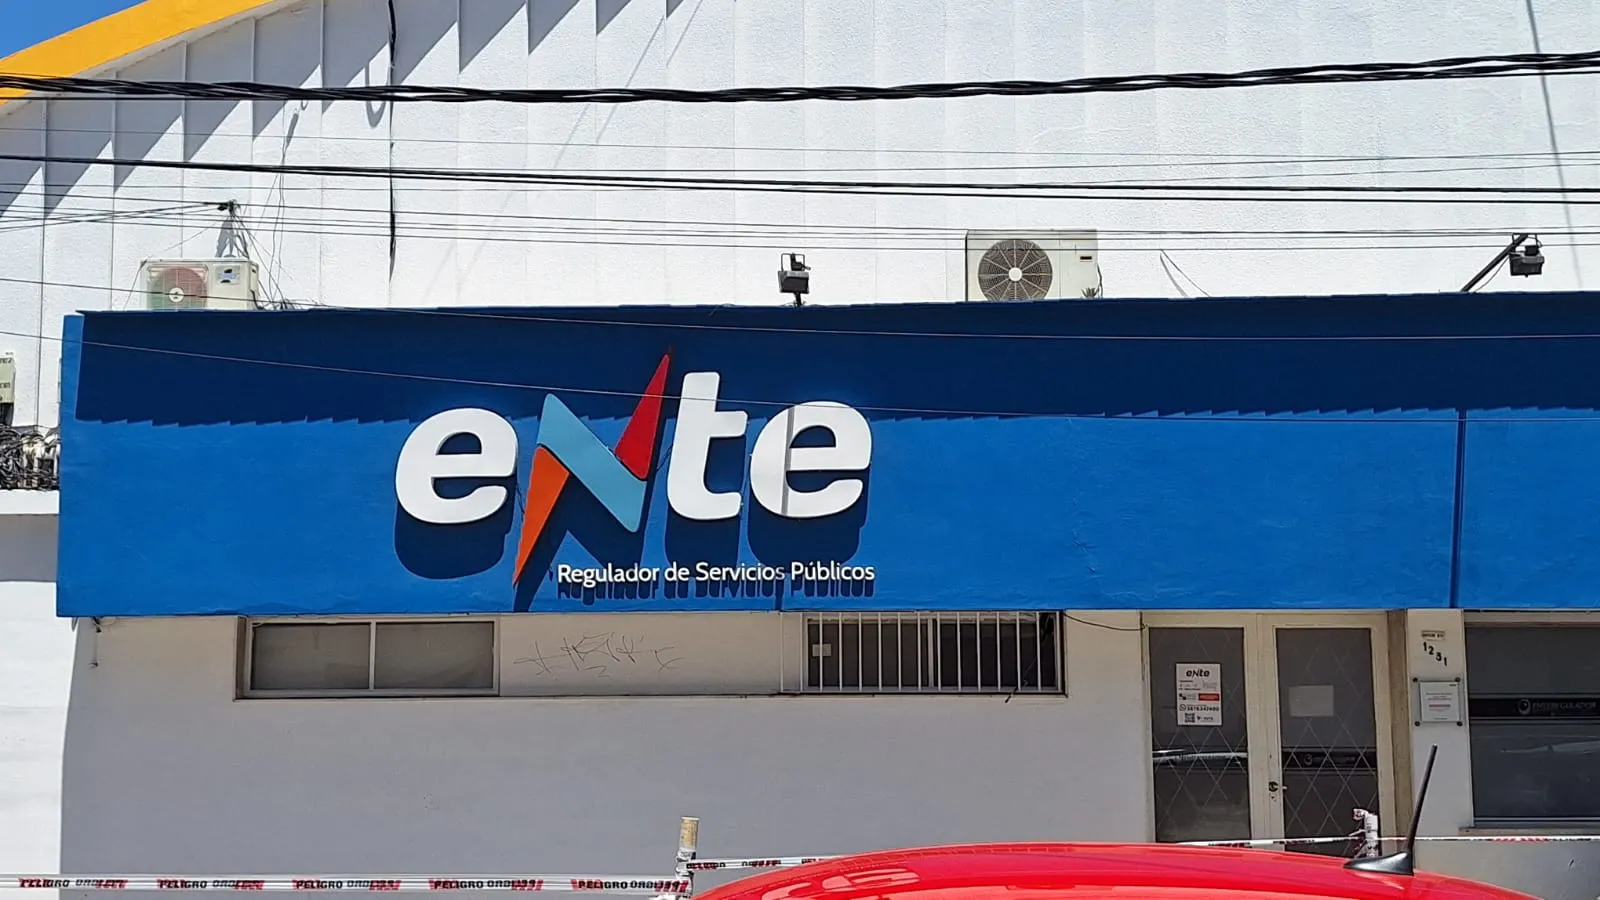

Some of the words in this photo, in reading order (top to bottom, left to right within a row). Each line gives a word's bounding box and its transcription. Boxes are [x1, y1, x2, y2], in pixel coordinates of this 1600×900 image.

[557, 563, 660, 587] Regulador
[664, 561, 690, 582] de
[695, 561, 786, 582] Servicios
[791, 560, 876, 581] Públicos
[1422, 641, 1448, 667] 1231
[295, 879, 343, 889] PELIGRO
[433, 879, 484, 889] PELIGRO
[577, 879, 628, 889] PELIGRO
